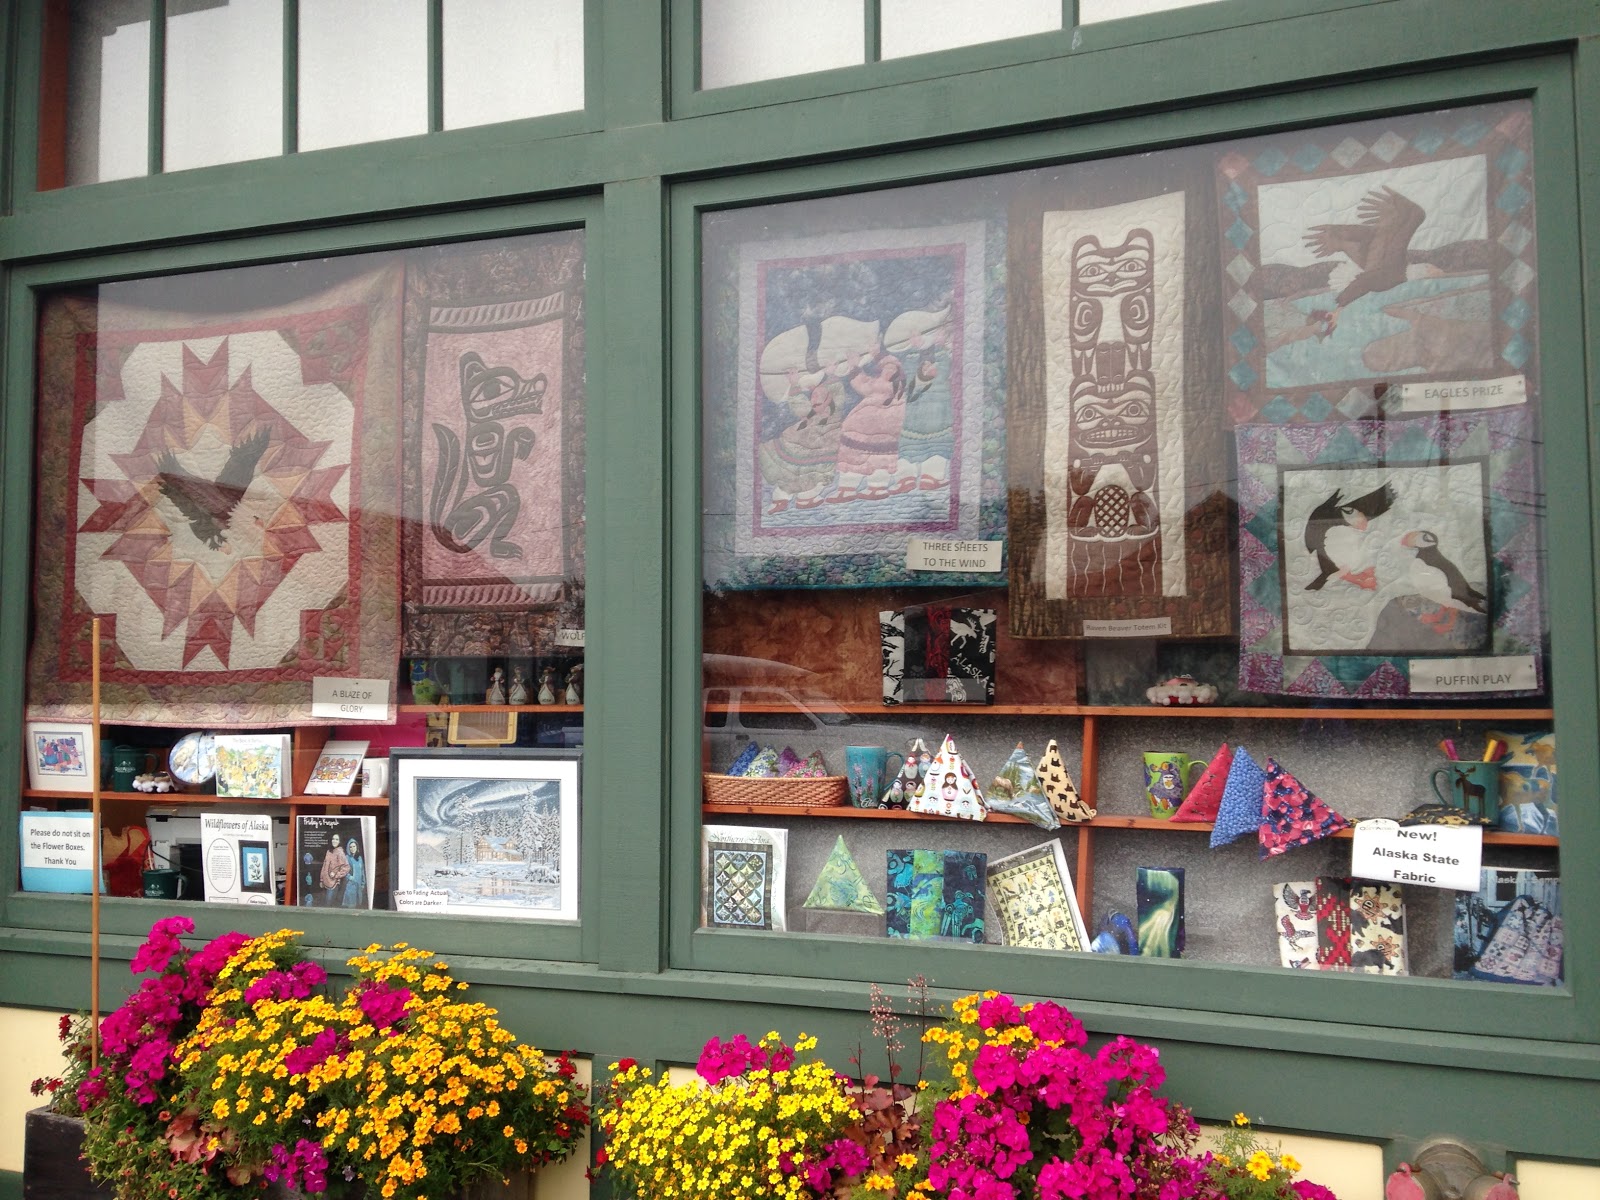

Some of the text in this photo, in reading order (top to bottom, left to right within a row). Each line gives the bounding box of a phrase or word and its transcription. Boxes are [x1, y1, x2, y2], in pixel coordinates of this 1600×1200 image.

[1424, 384, 1504, 399] EAGLES PRIZE
[923, 541, 988, 552] THREE SHEETS
[923, 557, 986, 568] TO THE WIND
[950, 652, 990, 689] ALASKA
[1435, 674, 1512, 686] PUFFIN PLAY
[340, 690, 360, 699] BLAZE
[362, 691, 372, 700] OF
[340, 704, 364, 713] GLORY
[204, 818, 269, 833] Wildflowers of Alaska
[30, 828, 51, 837] Please
[52, 829, 61, 837] do
[73, 830, 81, 838] sit
[1396, 829, 1437, 842] New!
[30, 842, 85, 851] the Flower Boxes.
[44, 857, 77, 865] Thank You
[1372, 847, 1460, 866] Alaska State
[1393, 869, 1437, 884] Fabric
[413, 889, 429, 897] Fading
